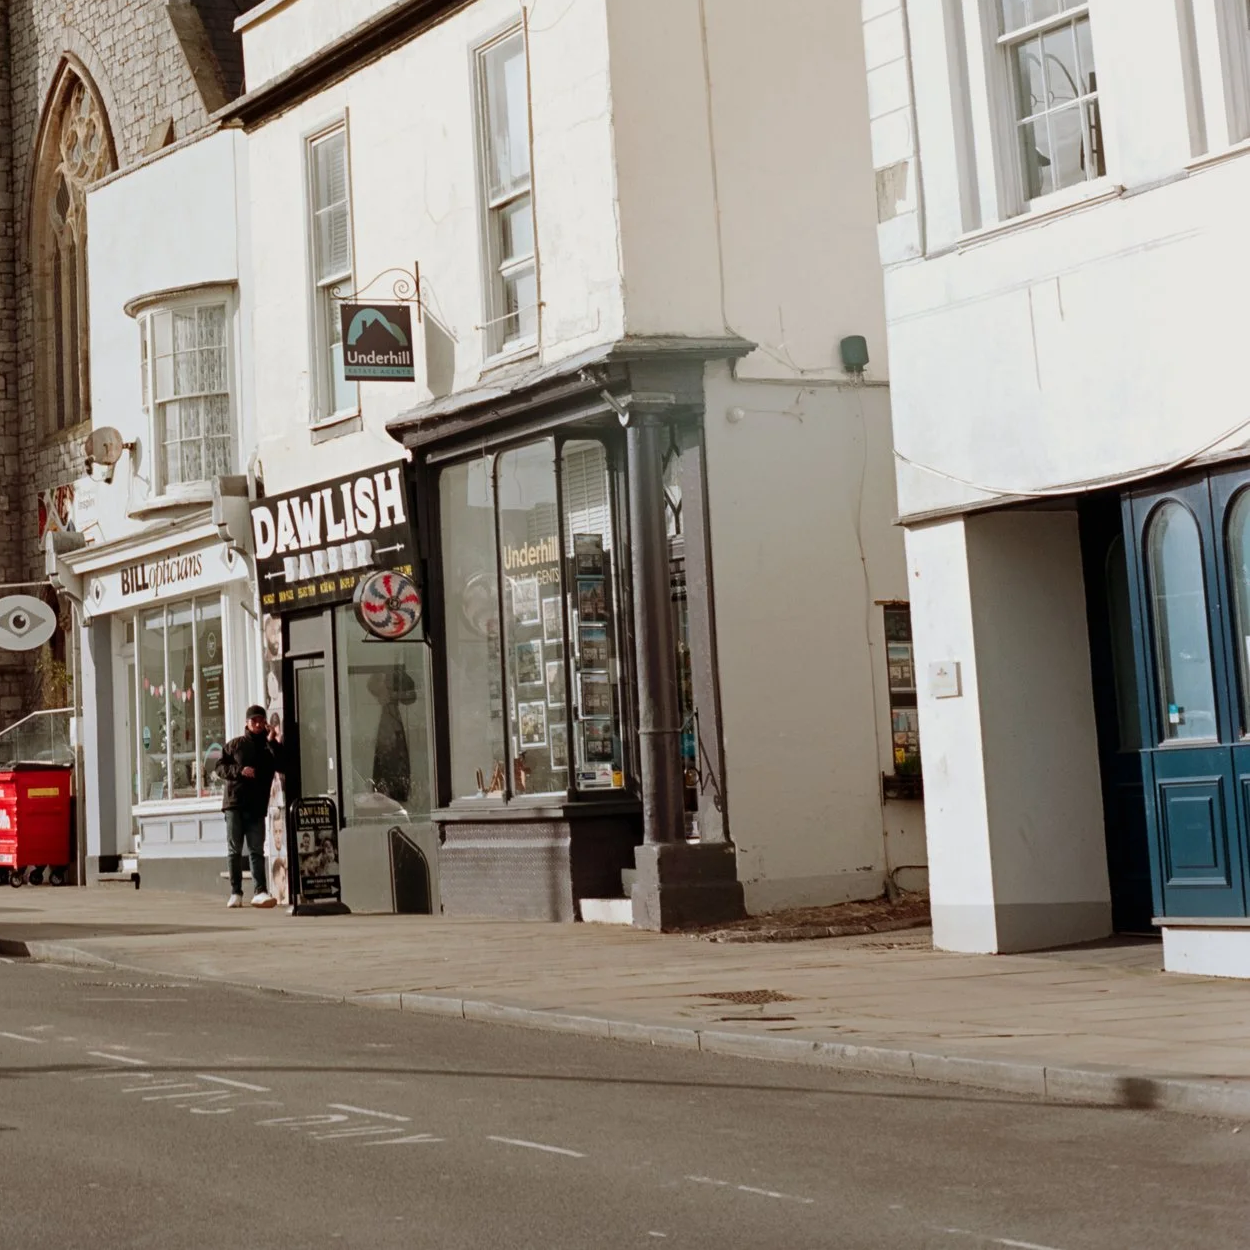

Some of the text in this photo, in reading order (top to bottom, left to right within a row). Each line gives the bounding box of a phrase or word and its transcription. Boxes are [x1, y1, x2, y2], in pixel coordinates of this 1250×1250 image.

[347, 350, 410, 365] Underhill
[251, 467, 406, 560] DAWLISH
[283, 539, 374, 583] BARBER
[503, 535, 559, 570] Underhill
